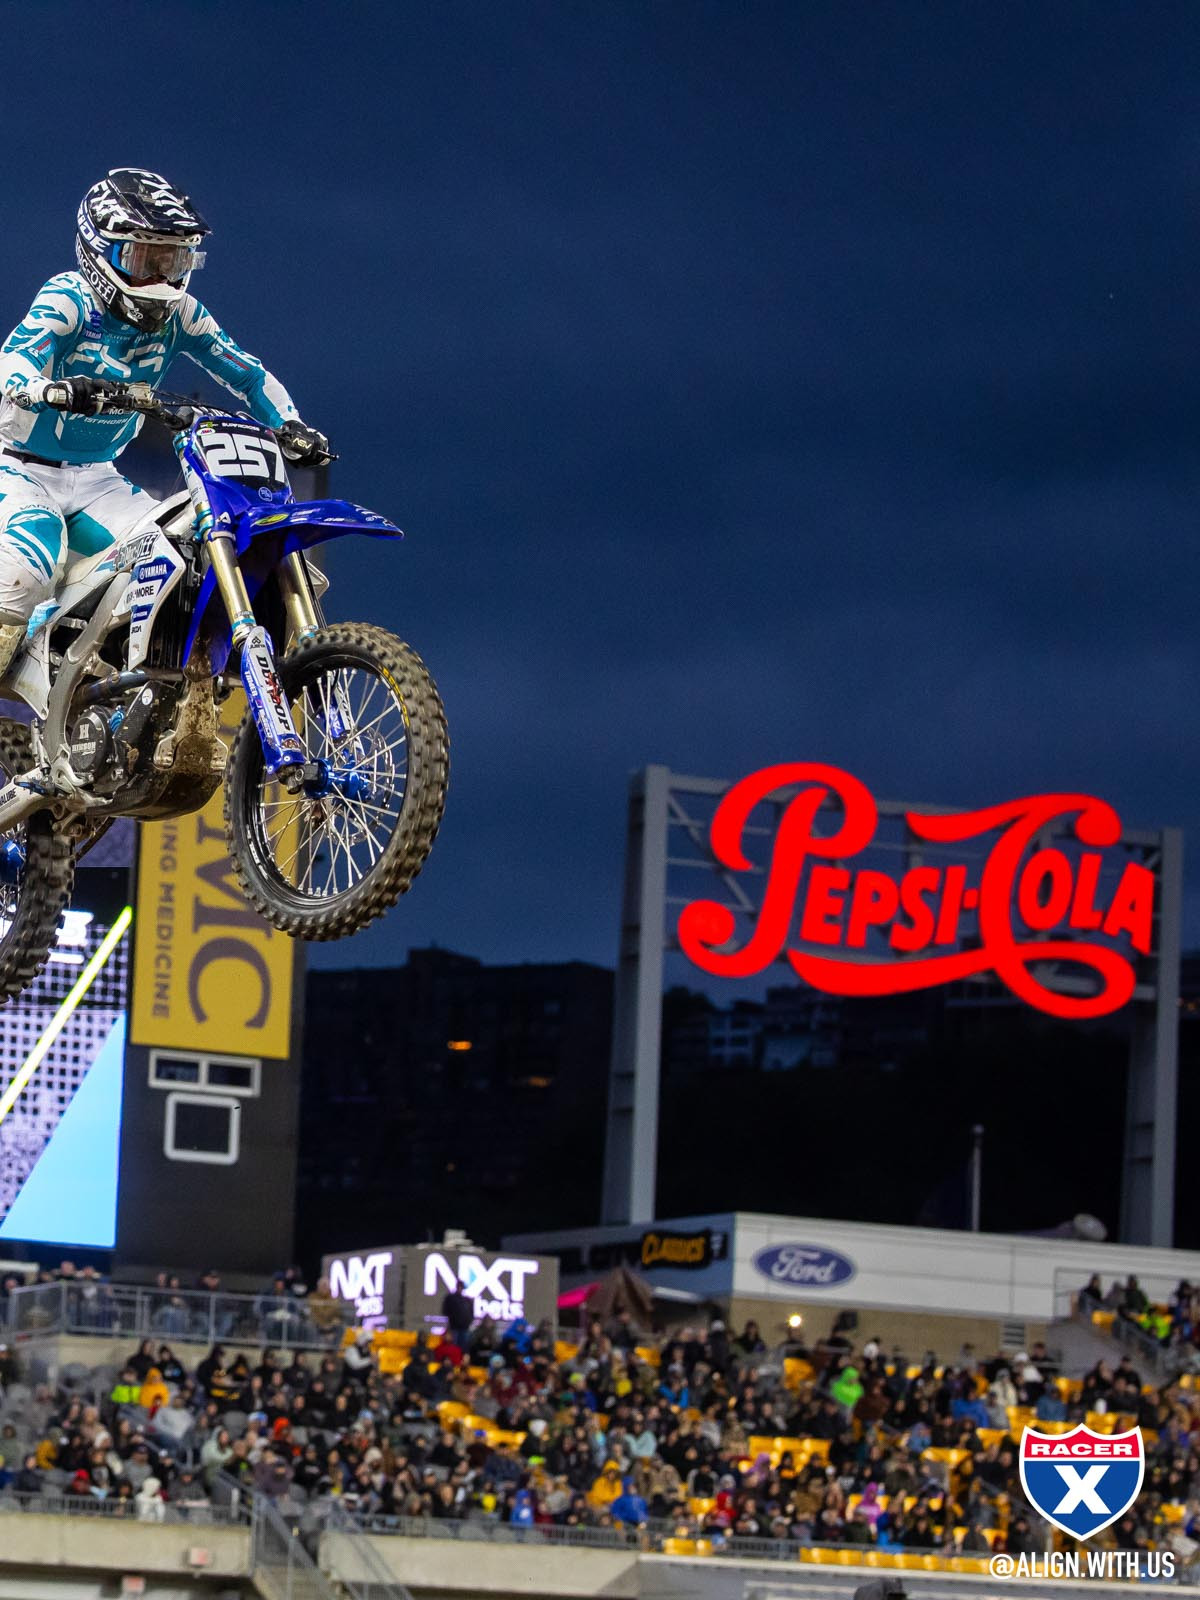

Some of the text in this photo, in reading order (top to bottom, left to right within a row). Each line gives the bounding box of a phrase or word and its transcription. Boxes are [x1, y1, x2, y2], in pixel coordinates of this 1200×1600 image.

[201, 432, 285, 483] 257
[145, 563, 168, 576] YAMAHA
[152, 883, 175, 1019] MEDICINE
[330, 1252, 392, 1300] NXT
[423, 1252, 539, 1301] NXT
[770, 1249, 837, 1283] Ford
